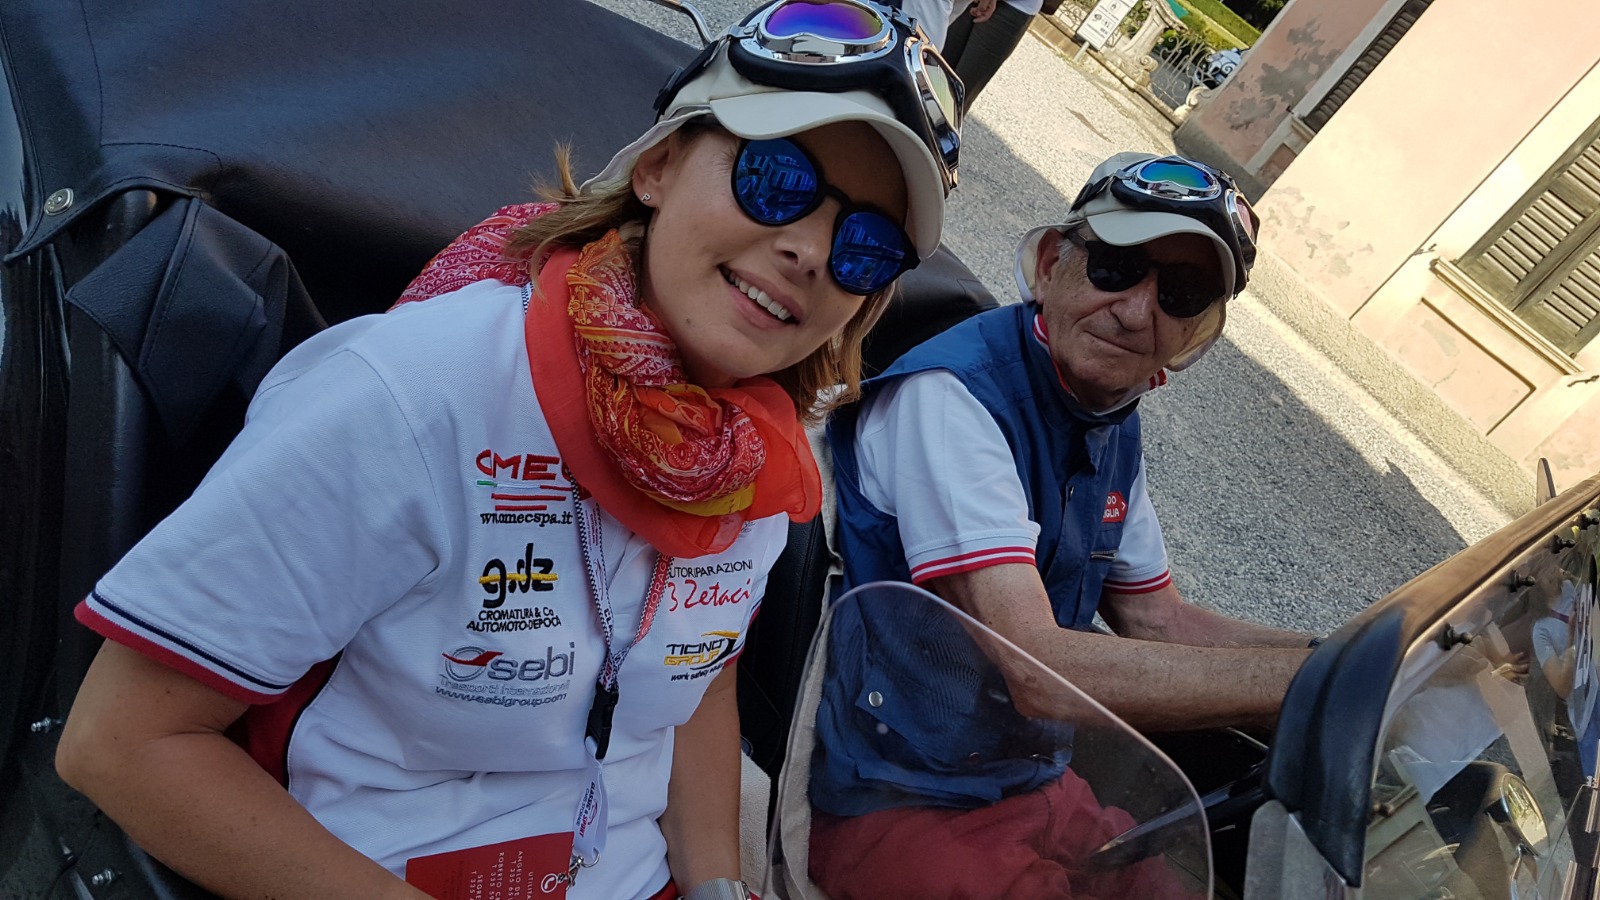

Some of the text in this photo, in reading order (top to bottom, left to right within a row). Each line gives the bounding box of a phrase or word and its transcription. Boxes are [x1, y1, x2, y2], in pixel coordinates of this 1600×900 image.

[669, 560, 753, 578] UTORIPARAZIONI
[684, 578, 751, 609] Zetaci
[478, 608, 534, 621] CROMATURA
[534, 607, 542, 618] &
[488, 642, 575, 681] sebi
[436, 686, 568, 708] www.sebigroup.com
[496, 852, 504, 888] ROBERTO
